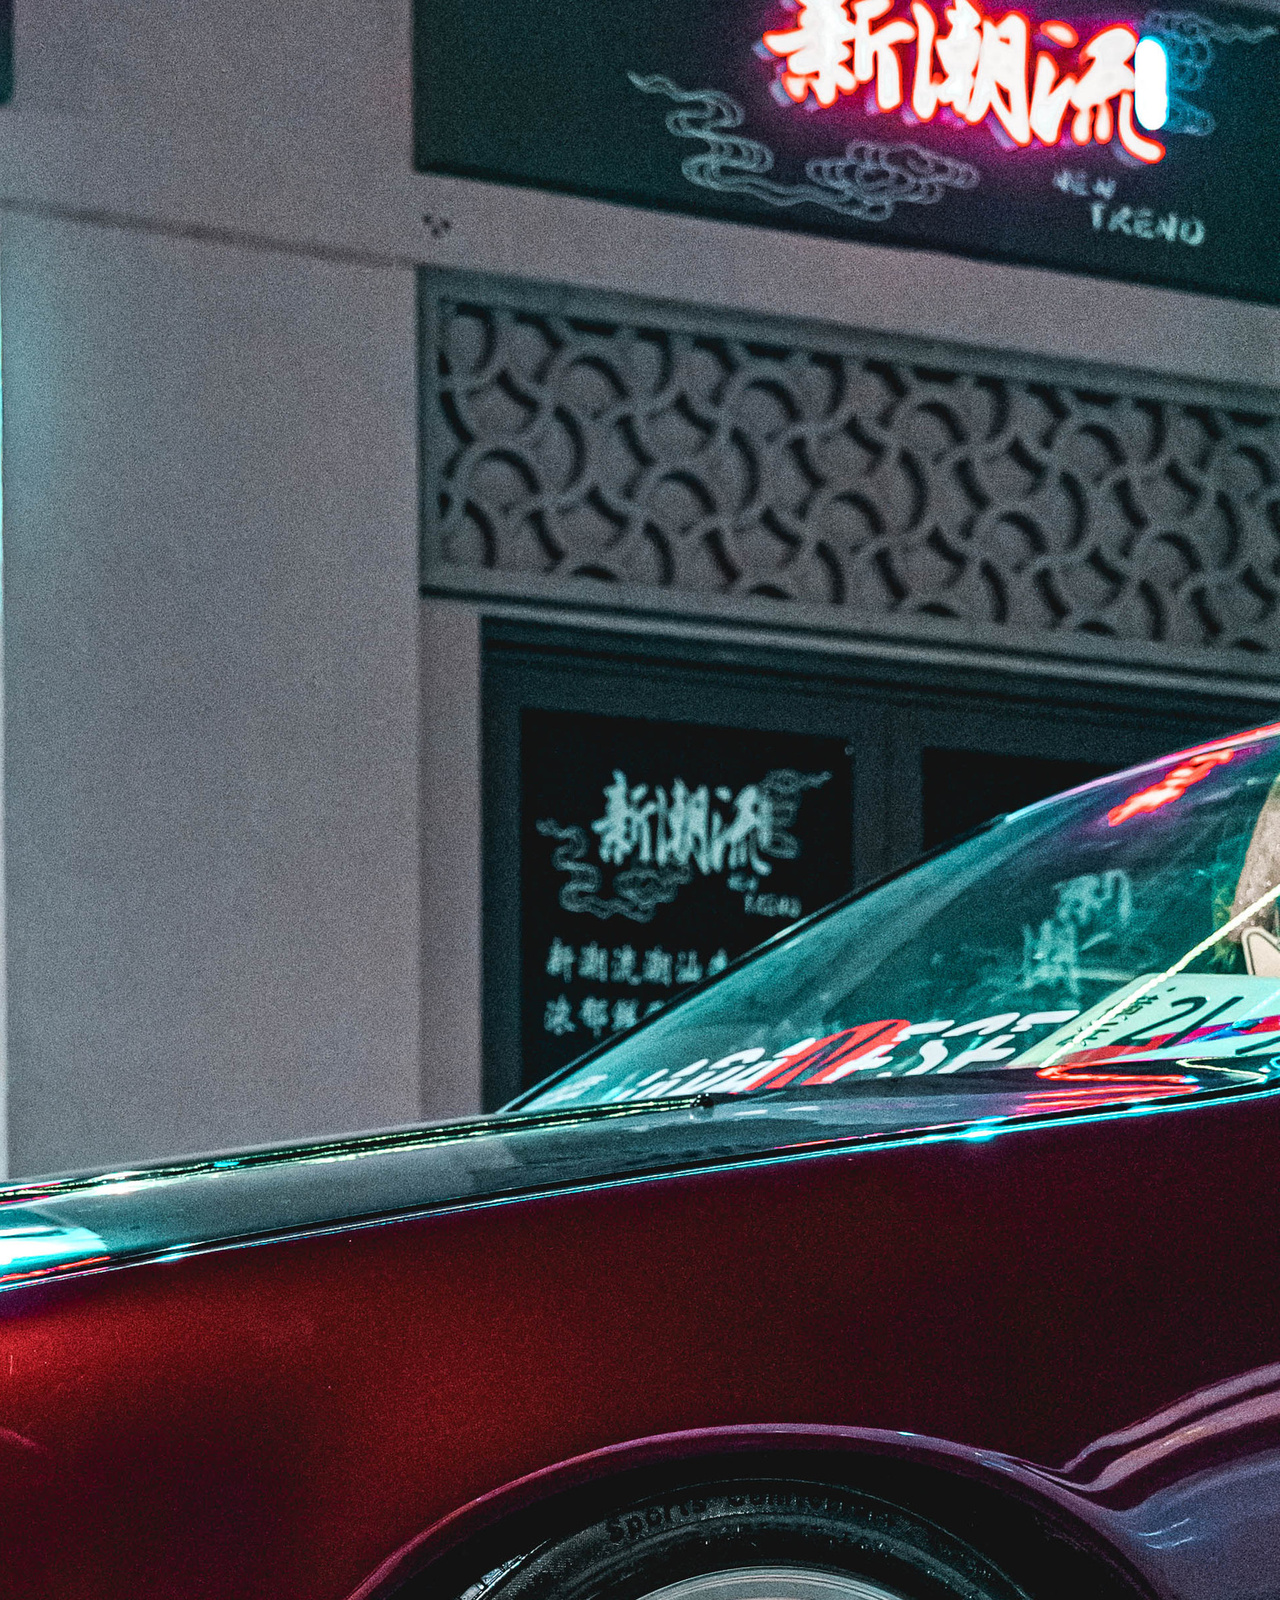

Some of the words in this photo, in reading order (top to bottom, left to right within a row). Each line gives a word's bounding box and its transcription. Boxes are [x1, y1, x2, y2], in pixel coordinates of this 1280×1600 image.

[761, 0, 1167, 164] 新潮流
[592, 768, 773, 876] 新潮流
